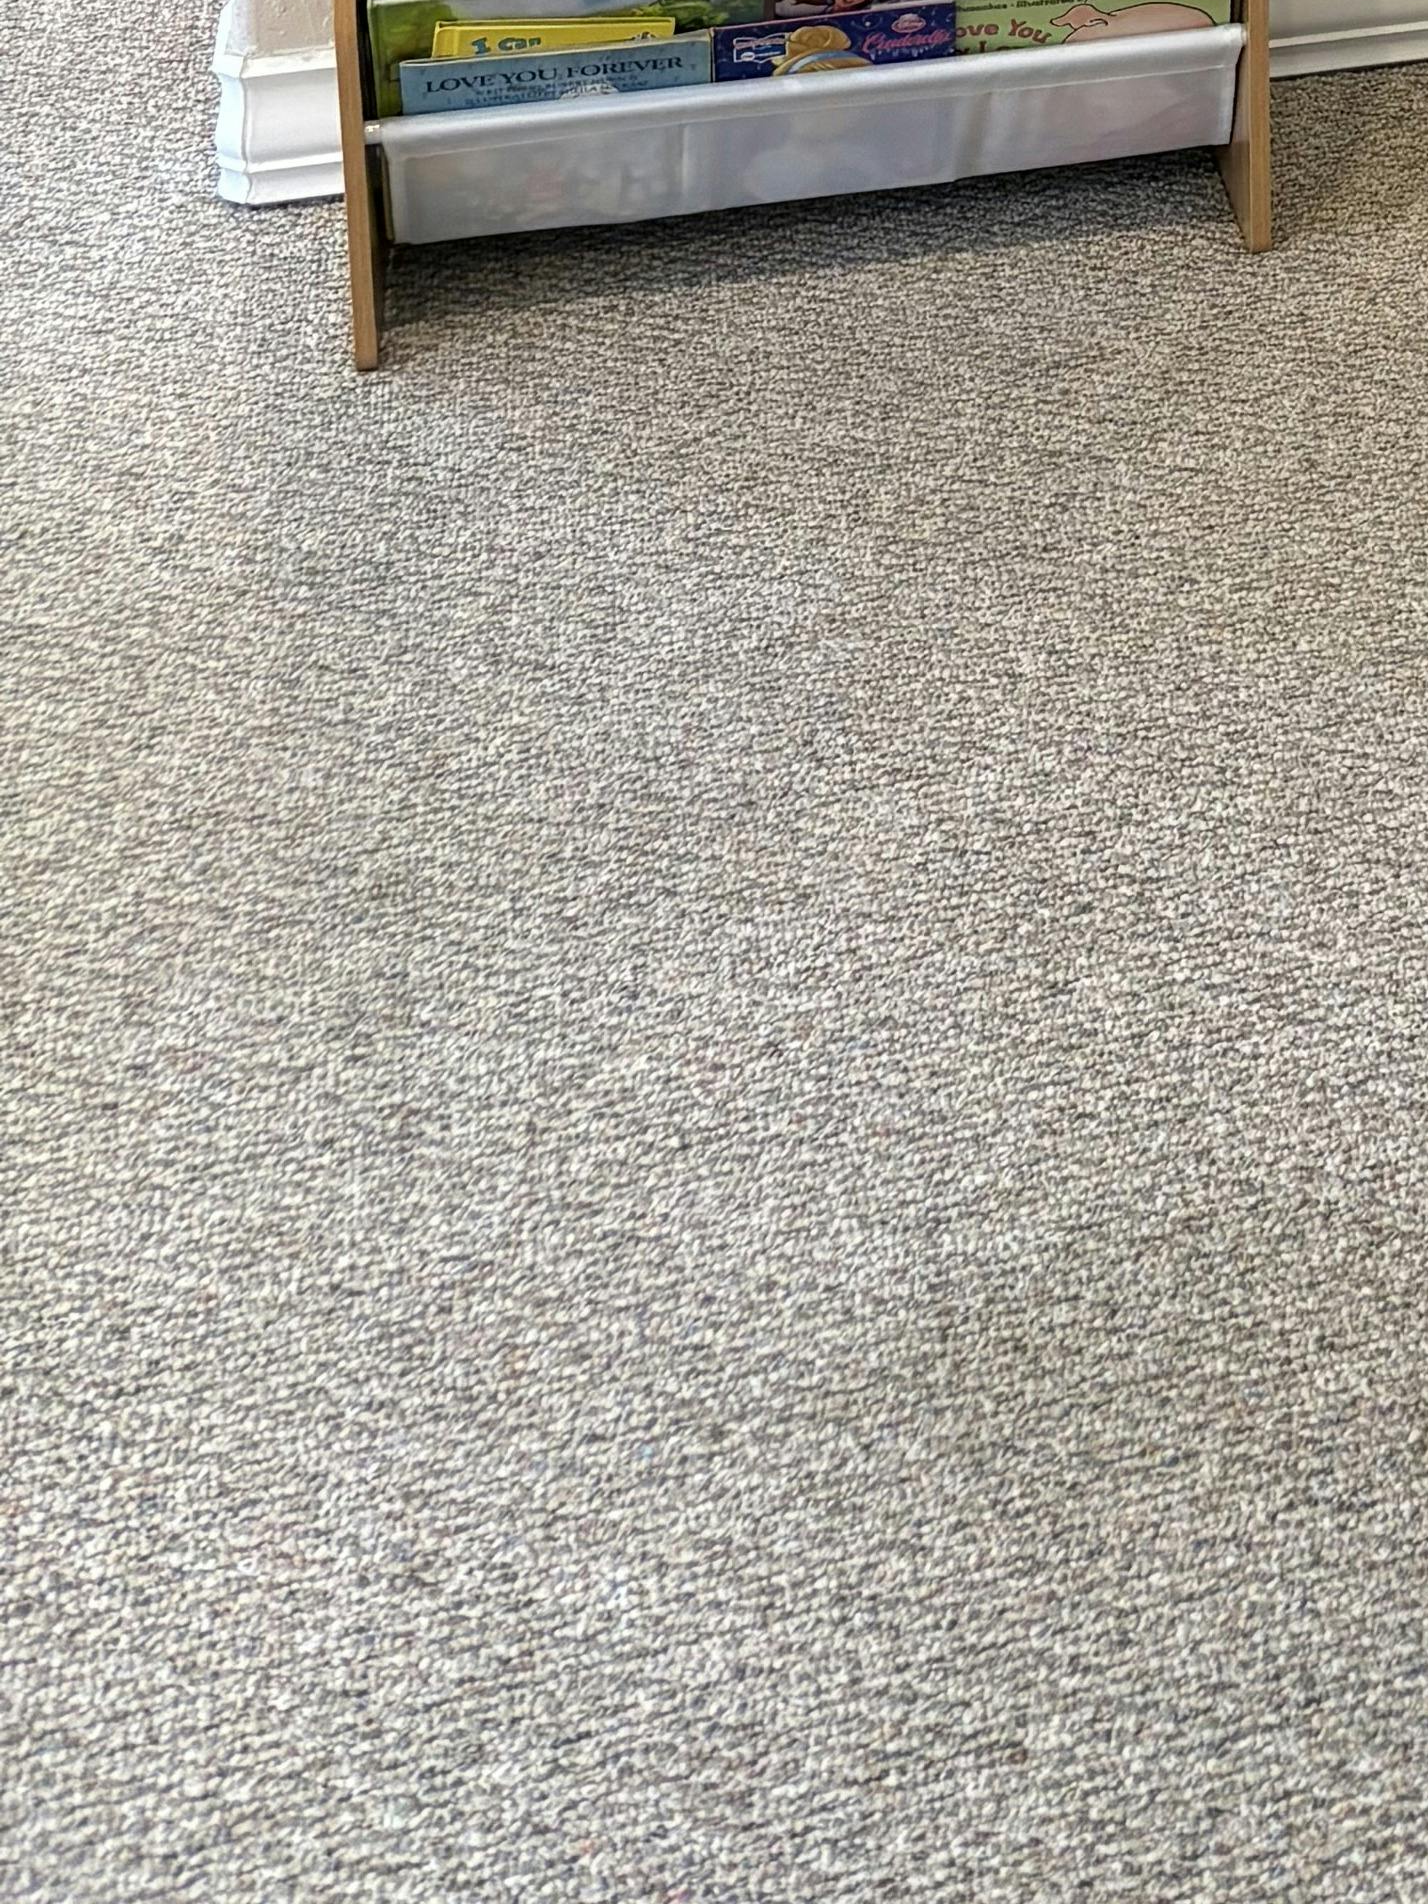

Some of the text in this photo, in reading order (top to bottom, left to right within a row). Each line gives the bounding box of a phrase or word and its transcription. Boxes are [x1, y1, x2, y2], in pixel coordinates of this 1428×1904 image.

[1007, 18, 1052, 43] You
[426, 76, 495, 93] LOVE
[500, 68, 557, 84] YOU
[566, 57, 684, 79] FOREVER
